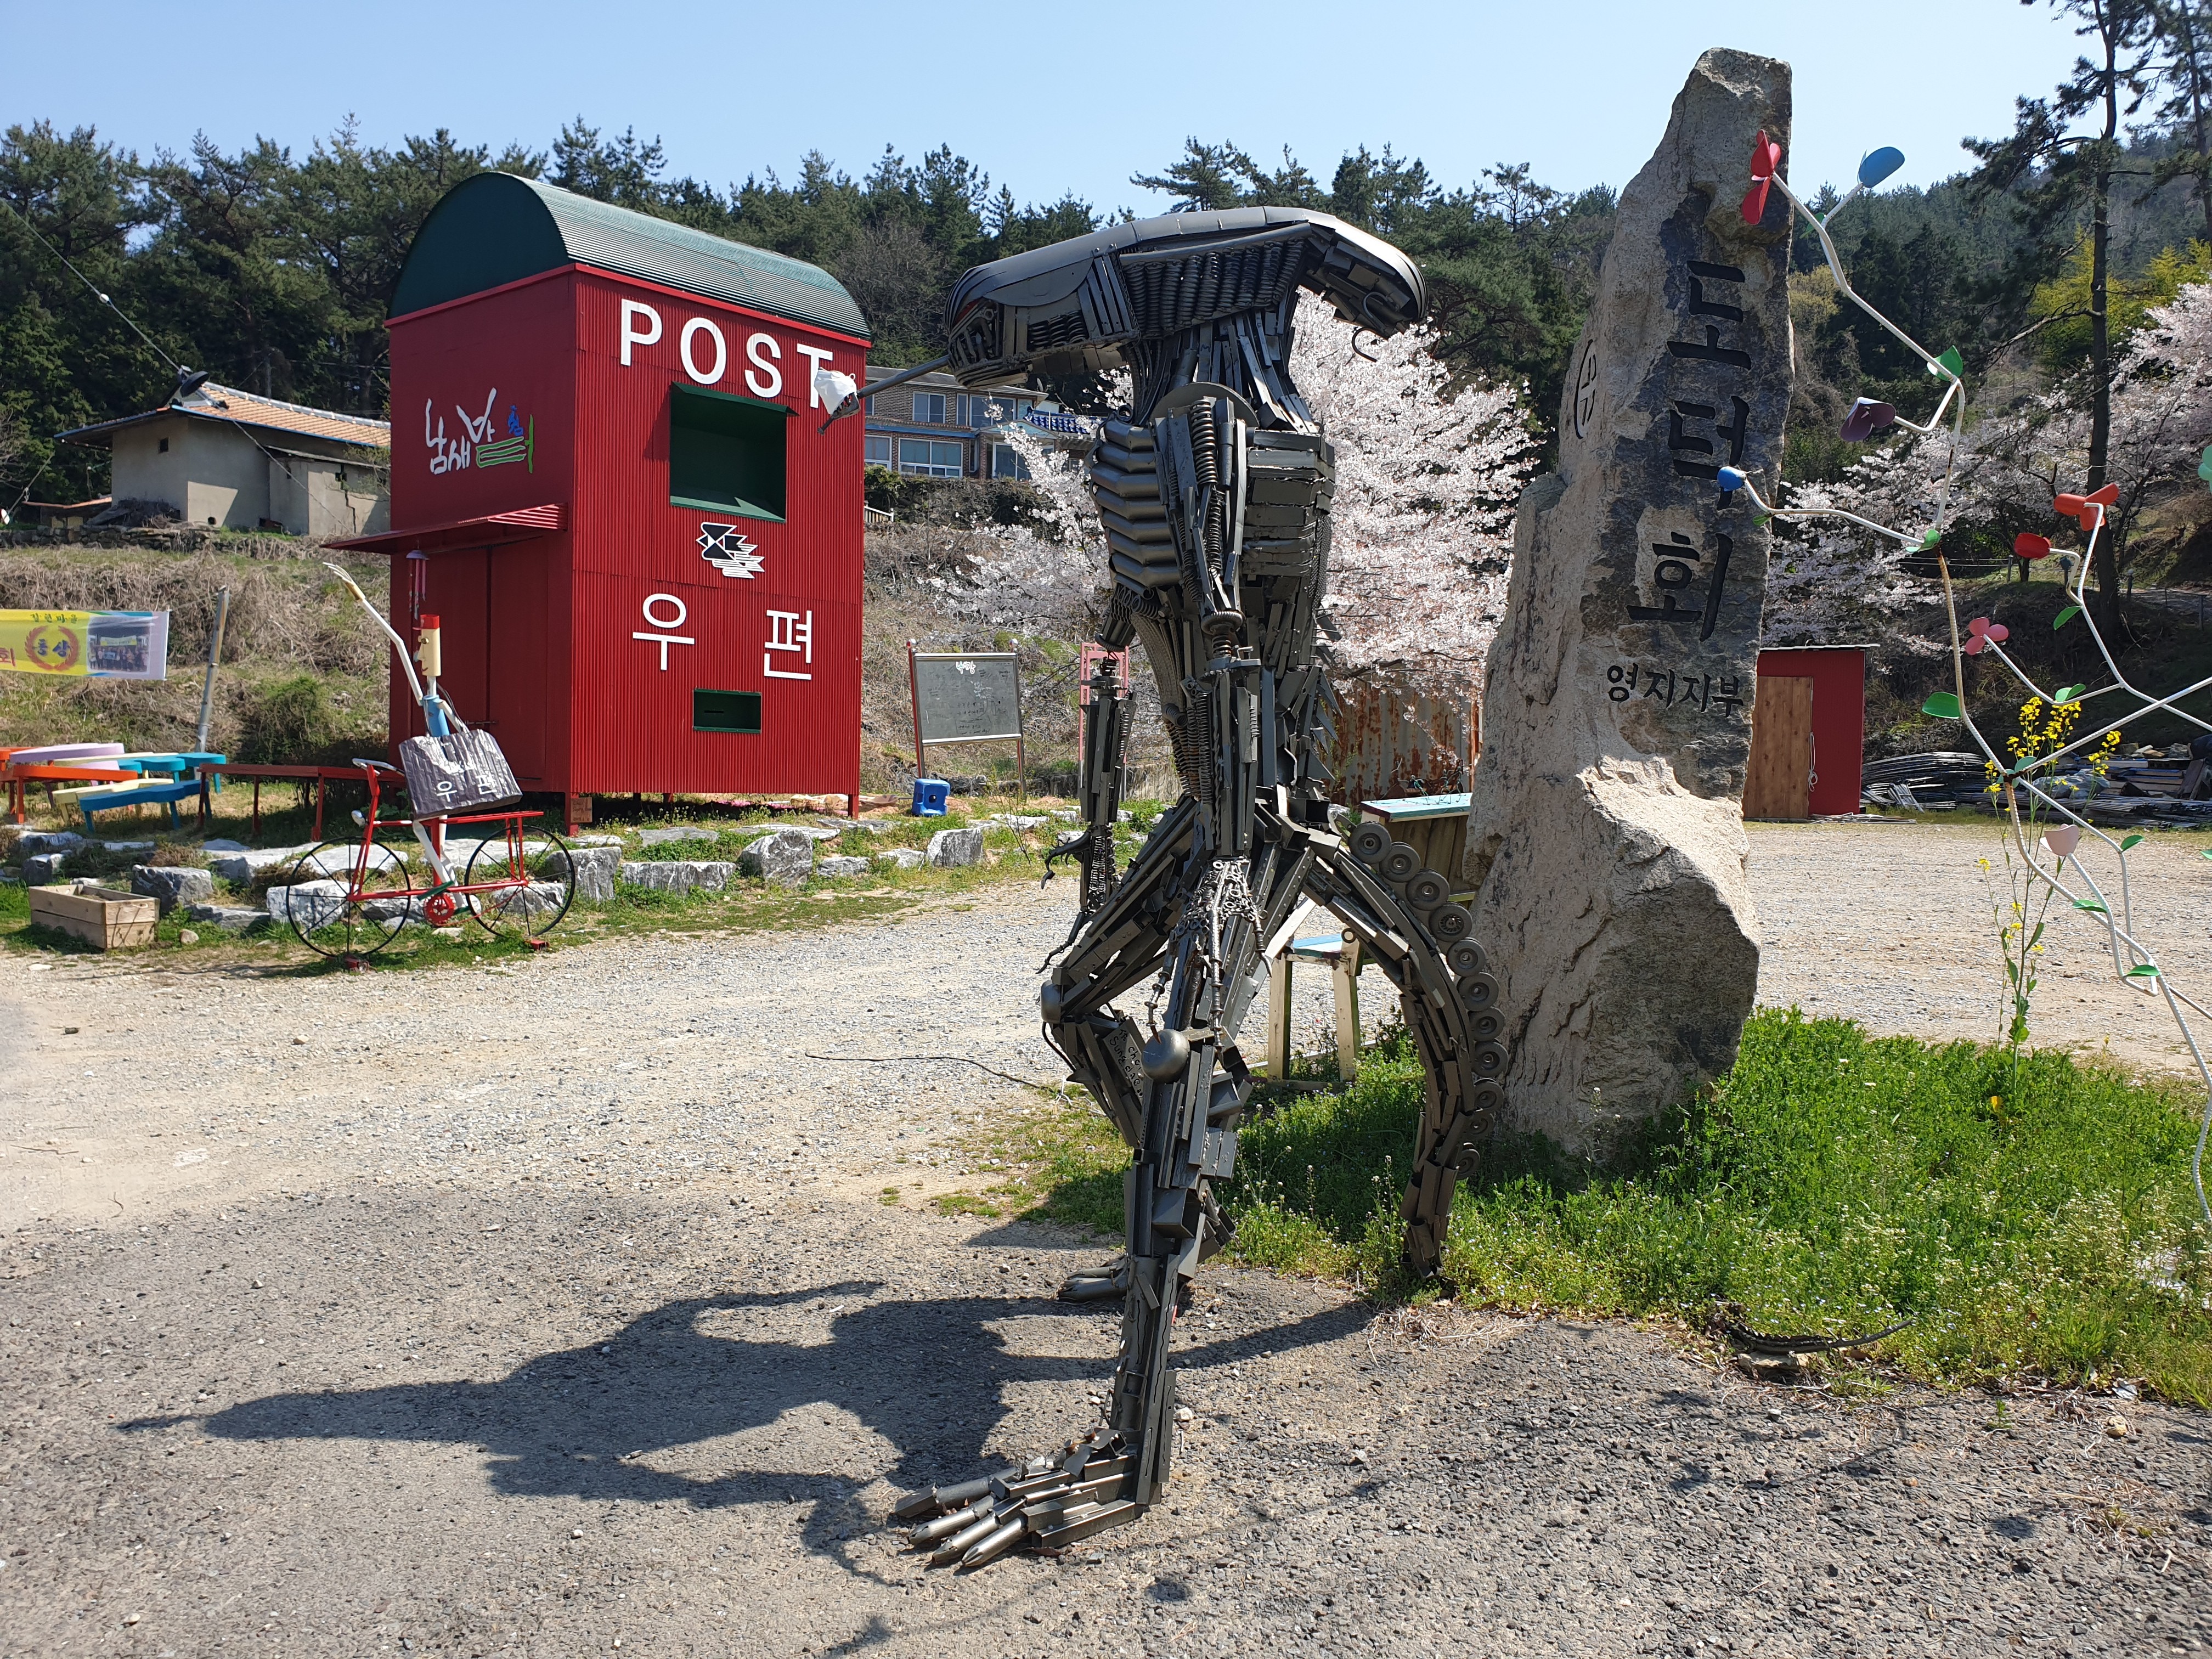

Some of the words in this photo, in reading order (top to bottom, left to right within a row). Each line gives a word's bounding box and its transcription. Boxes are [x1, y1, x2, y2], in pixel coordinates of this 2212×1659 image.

[620, 298, 833, 409] POST
[1626, 259, 1752, 642] 도덕회
[633, 593, 812, 680] 우편
[1606, 662, 1744, 718] 영지지부
